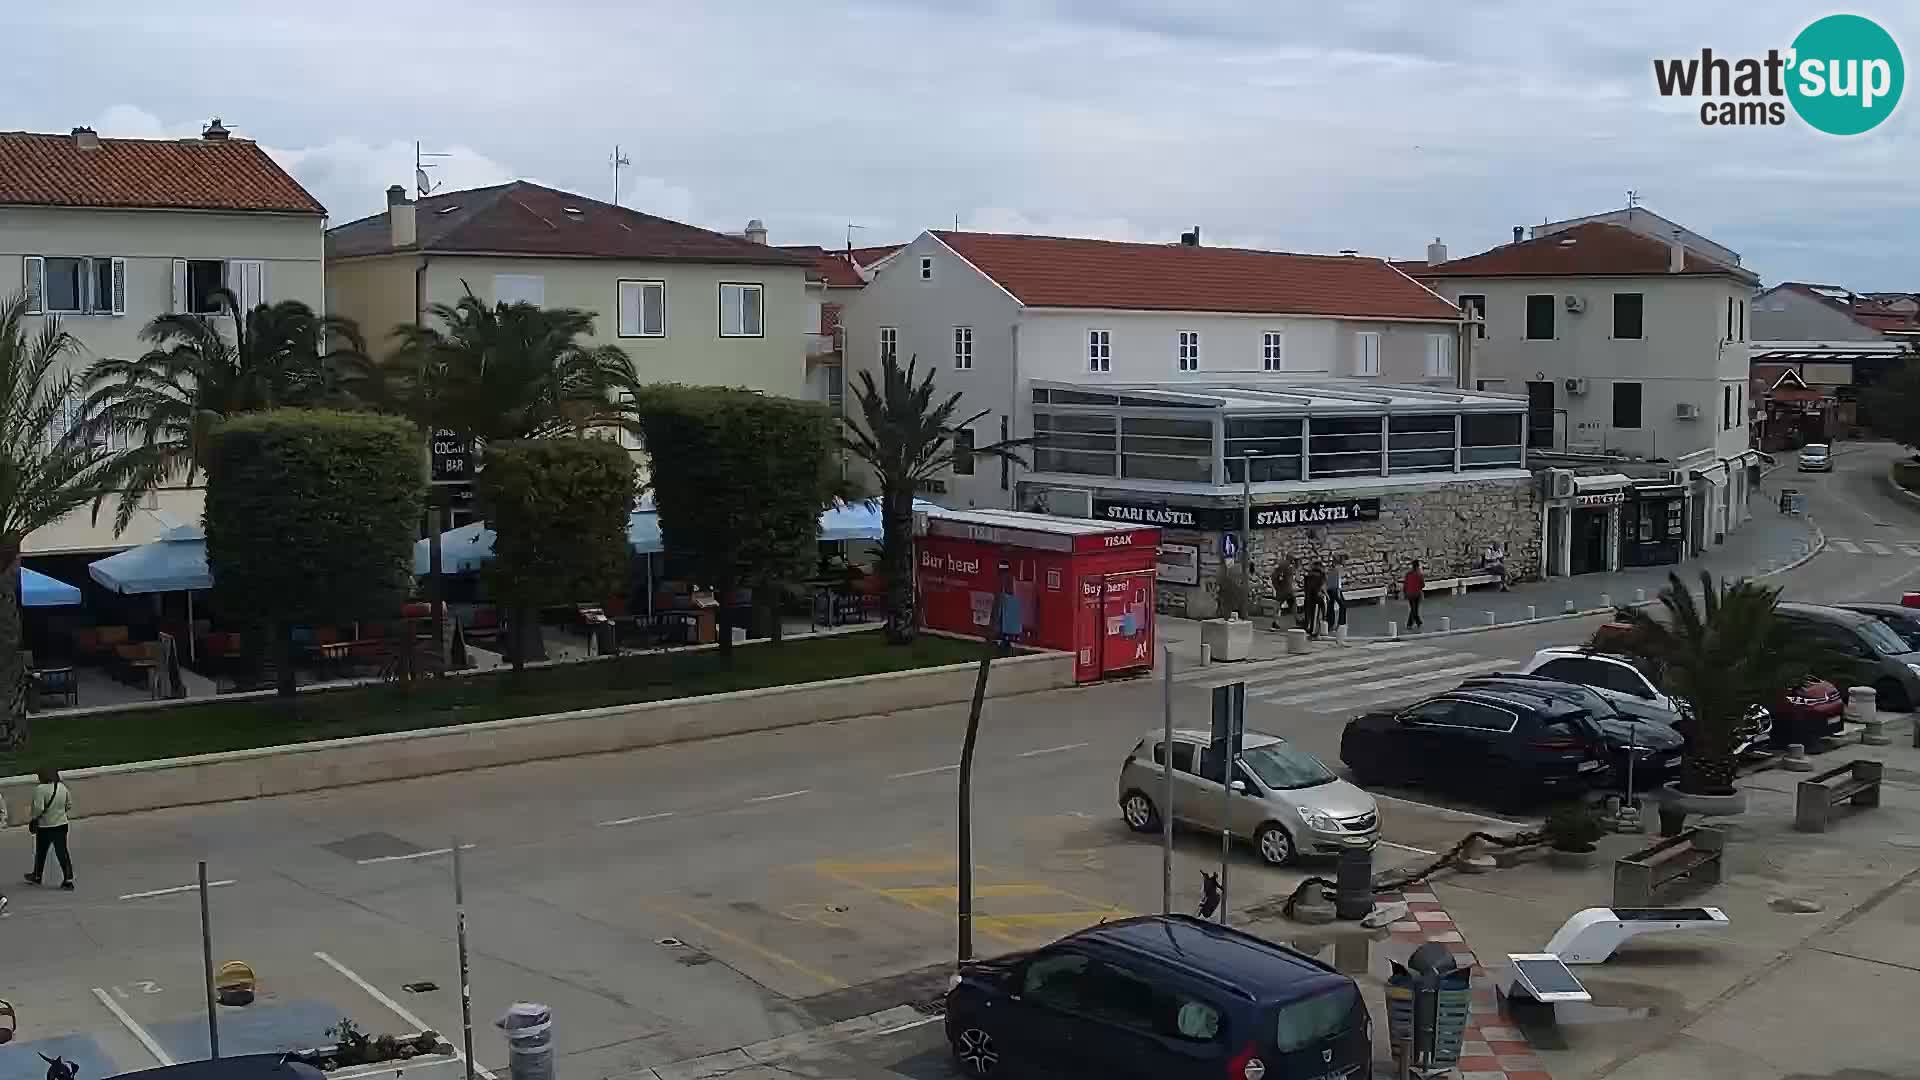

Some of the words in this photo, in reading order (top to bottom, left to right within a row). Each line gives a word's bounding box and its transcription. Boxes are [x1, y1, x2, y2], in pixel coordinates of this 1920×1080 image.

[1107, 506, 1143, 520] STARI
[1146, 508, 1195, 525] KAŠTEL
[1257, 509, 1296, 524] STARI
[1299, 504, 1348, 521] KAŠTEL
[1104, 534, 1132, 547] TISAK
[948, 552, 979, 574] here!
[1083, 583, 1101, 596] Buy
[1107, 580, 1129, 592] here!
